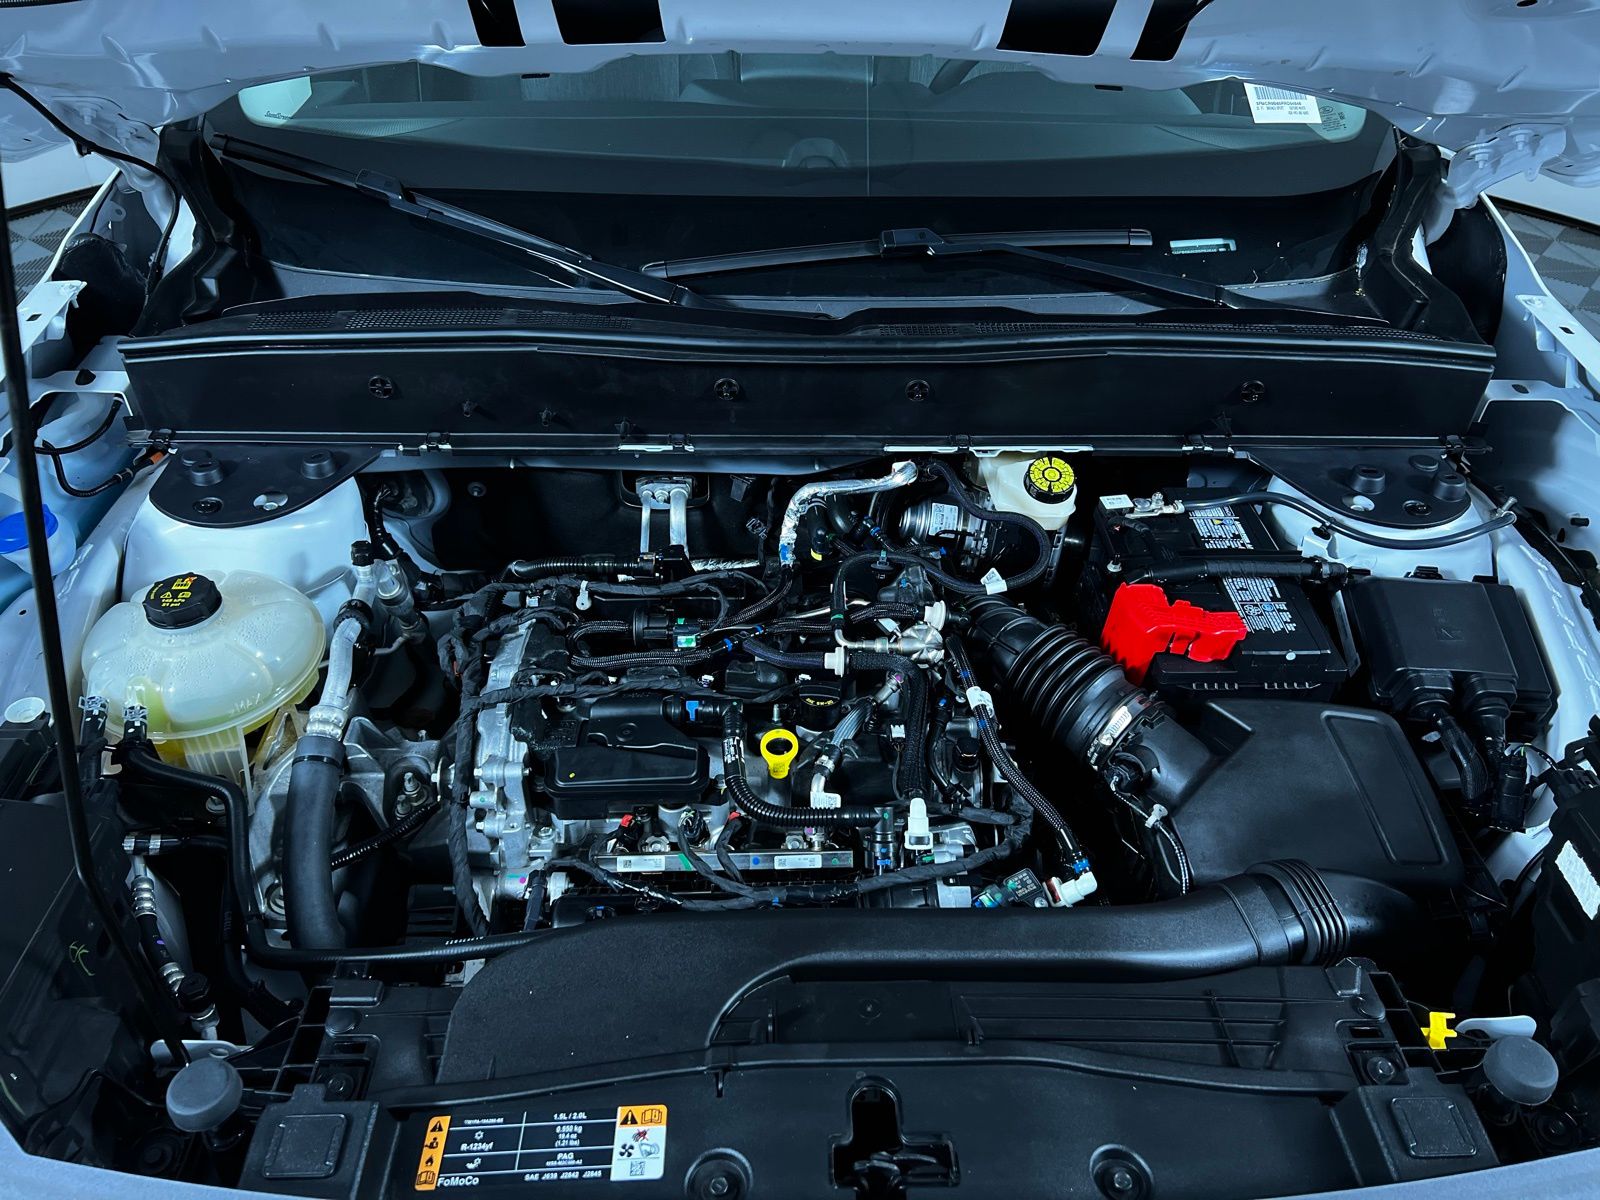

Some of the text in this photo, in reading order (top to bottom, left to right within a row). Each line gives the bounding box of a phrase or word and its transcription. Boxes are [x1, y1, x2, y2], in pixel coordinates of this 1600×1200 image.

[574, 1125, 583, 1134] kg
[460, 1141, 494, 1152] R-1234yf
[557, 1152, 574, 1160] PAG
[437, 1175, 479, 1187] FoMoCo
[524, 1173, 540, 1182] SAE
